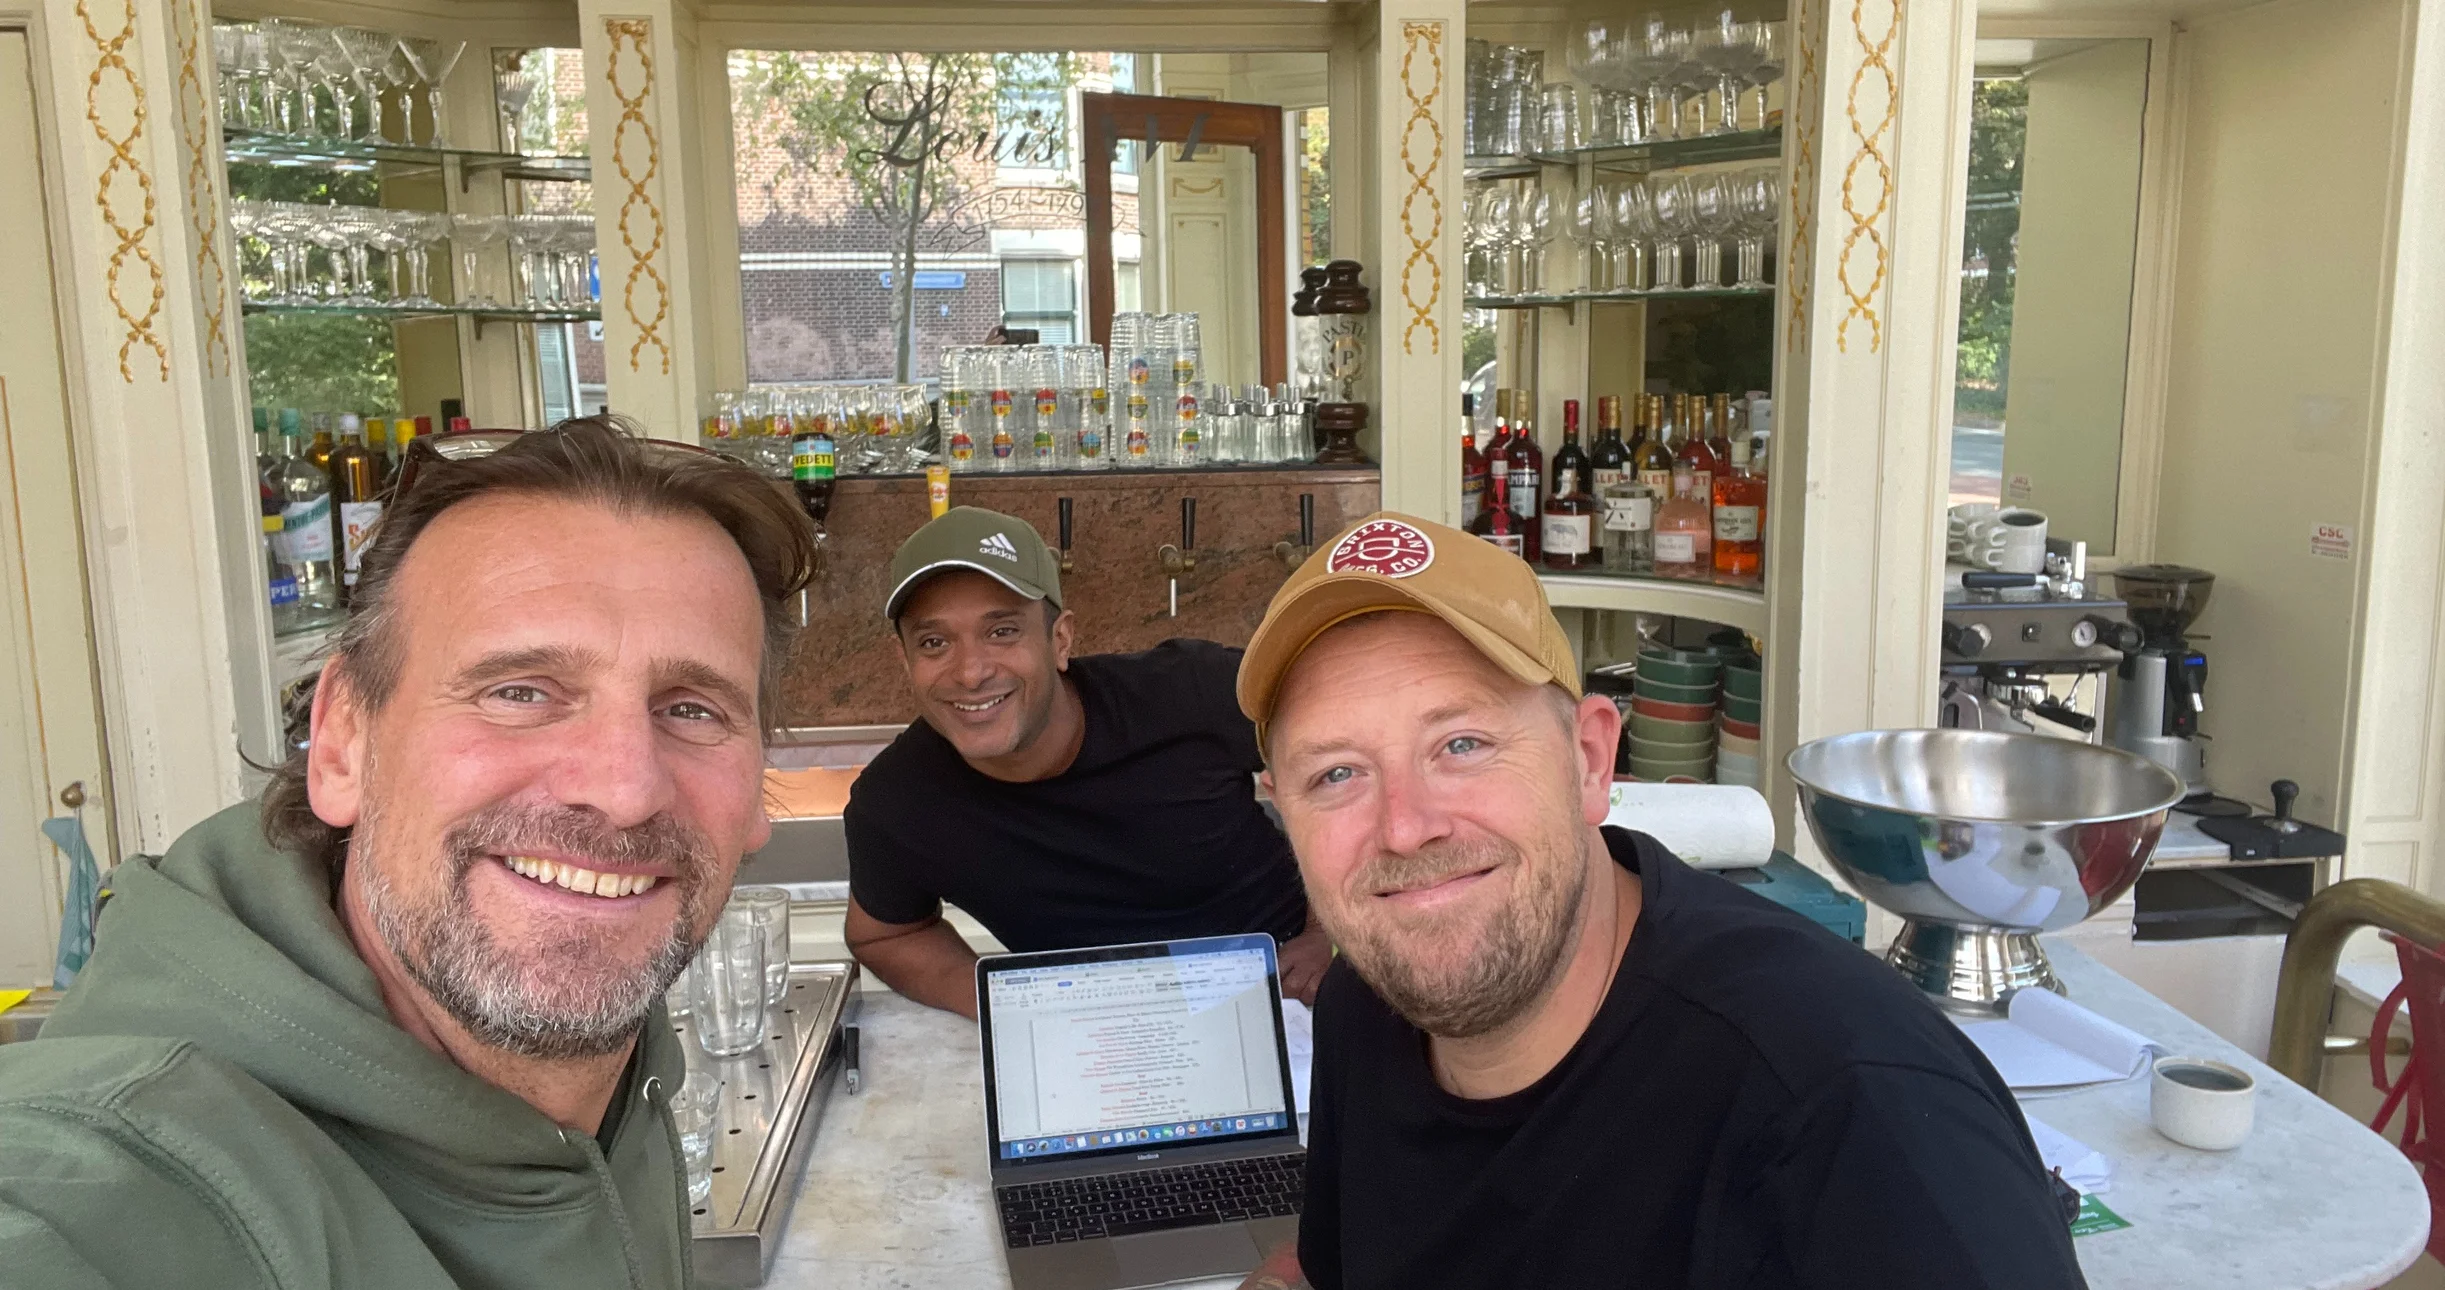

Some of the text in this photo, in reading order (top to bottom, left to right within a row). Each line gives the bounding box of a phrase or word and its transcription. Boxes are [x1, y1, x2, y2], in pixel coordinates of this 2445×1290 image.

[855, 80, 1057, 168] Louis
[1322, 319, 1366, 345] PASTI
[794, 454, 832, 465] VEDETT
[1509, 473, 1540, 485] MPARI
[1336, 523, 1425, 556] BRIXTON
[979, 547, 1018, 562] adidas
[1390, 557, 1422, 573] CO.
